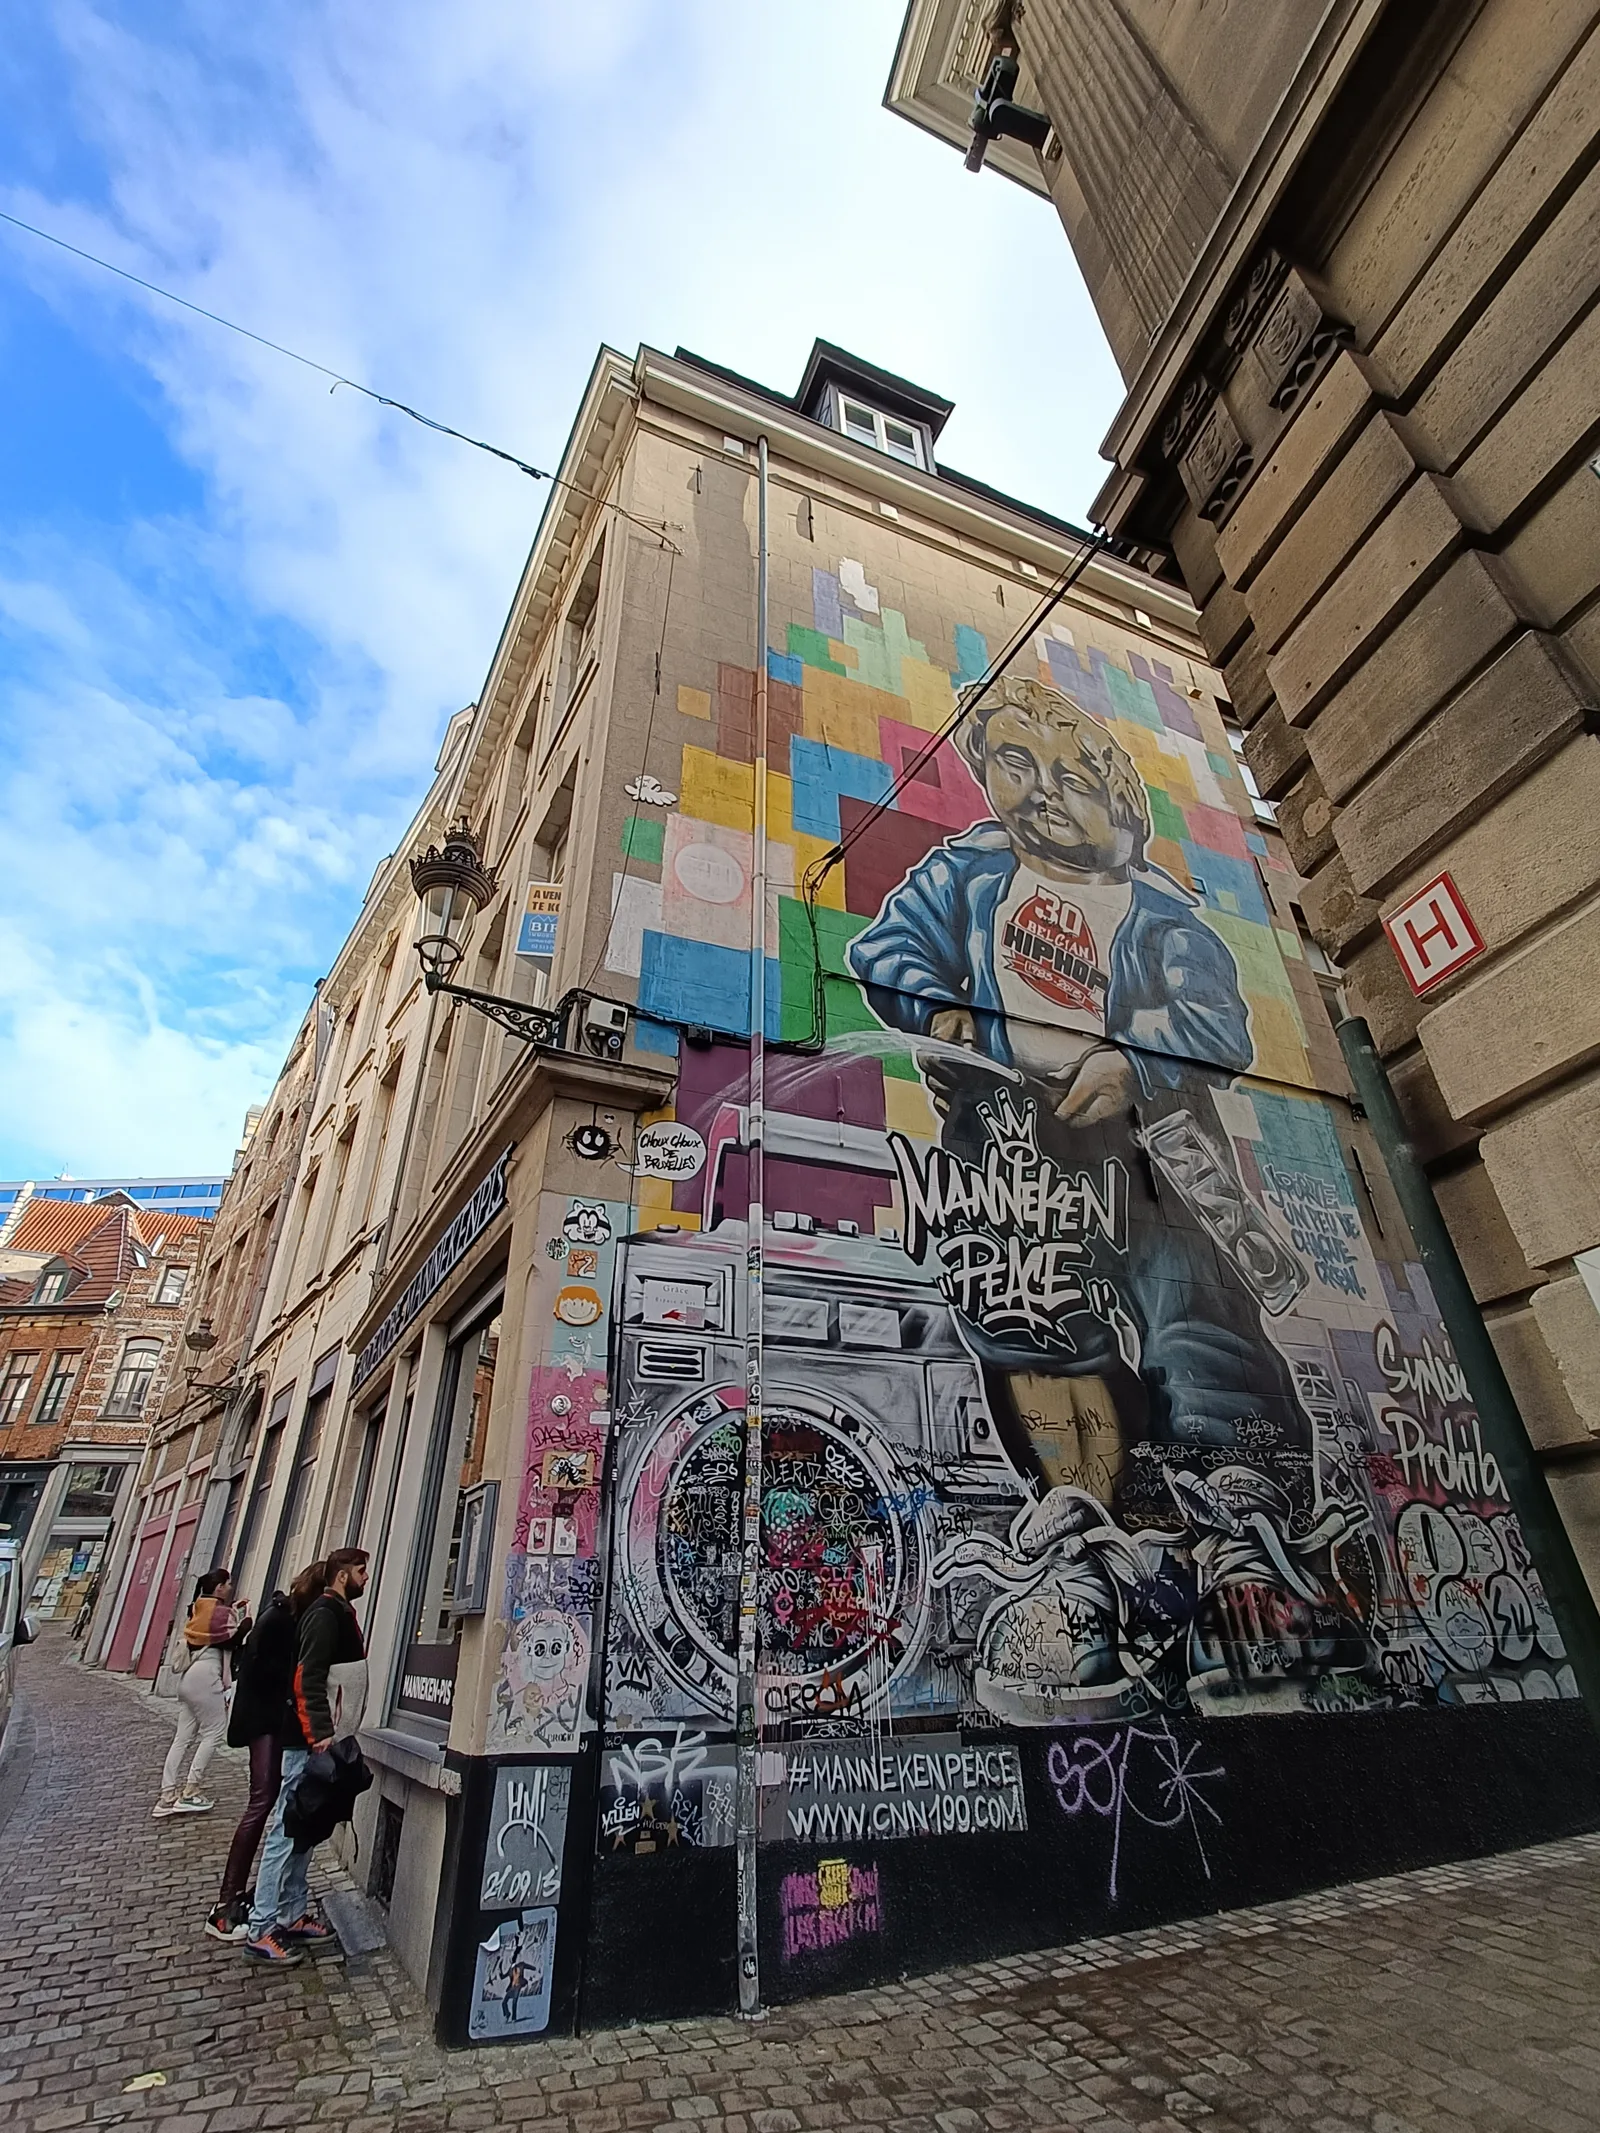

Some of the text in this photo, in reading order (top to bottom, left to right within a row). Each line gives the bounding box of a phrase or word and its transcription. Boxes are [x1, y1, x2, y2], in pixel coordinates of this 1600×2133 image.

[532, 901, 545, 911] TE
[533, 890, 541, 899] A
[1034, 886, 1084, 938] 30
[1026, 919, 1090, 960] BELGIAN
[1403, 899, 1459, 970] H
[662, 1147, 680, 1159] DE
[888, 1132, 1118, 1254] MANNEKEN
[787, 1785, 1025, 1837] WWW.CNN199.COM
